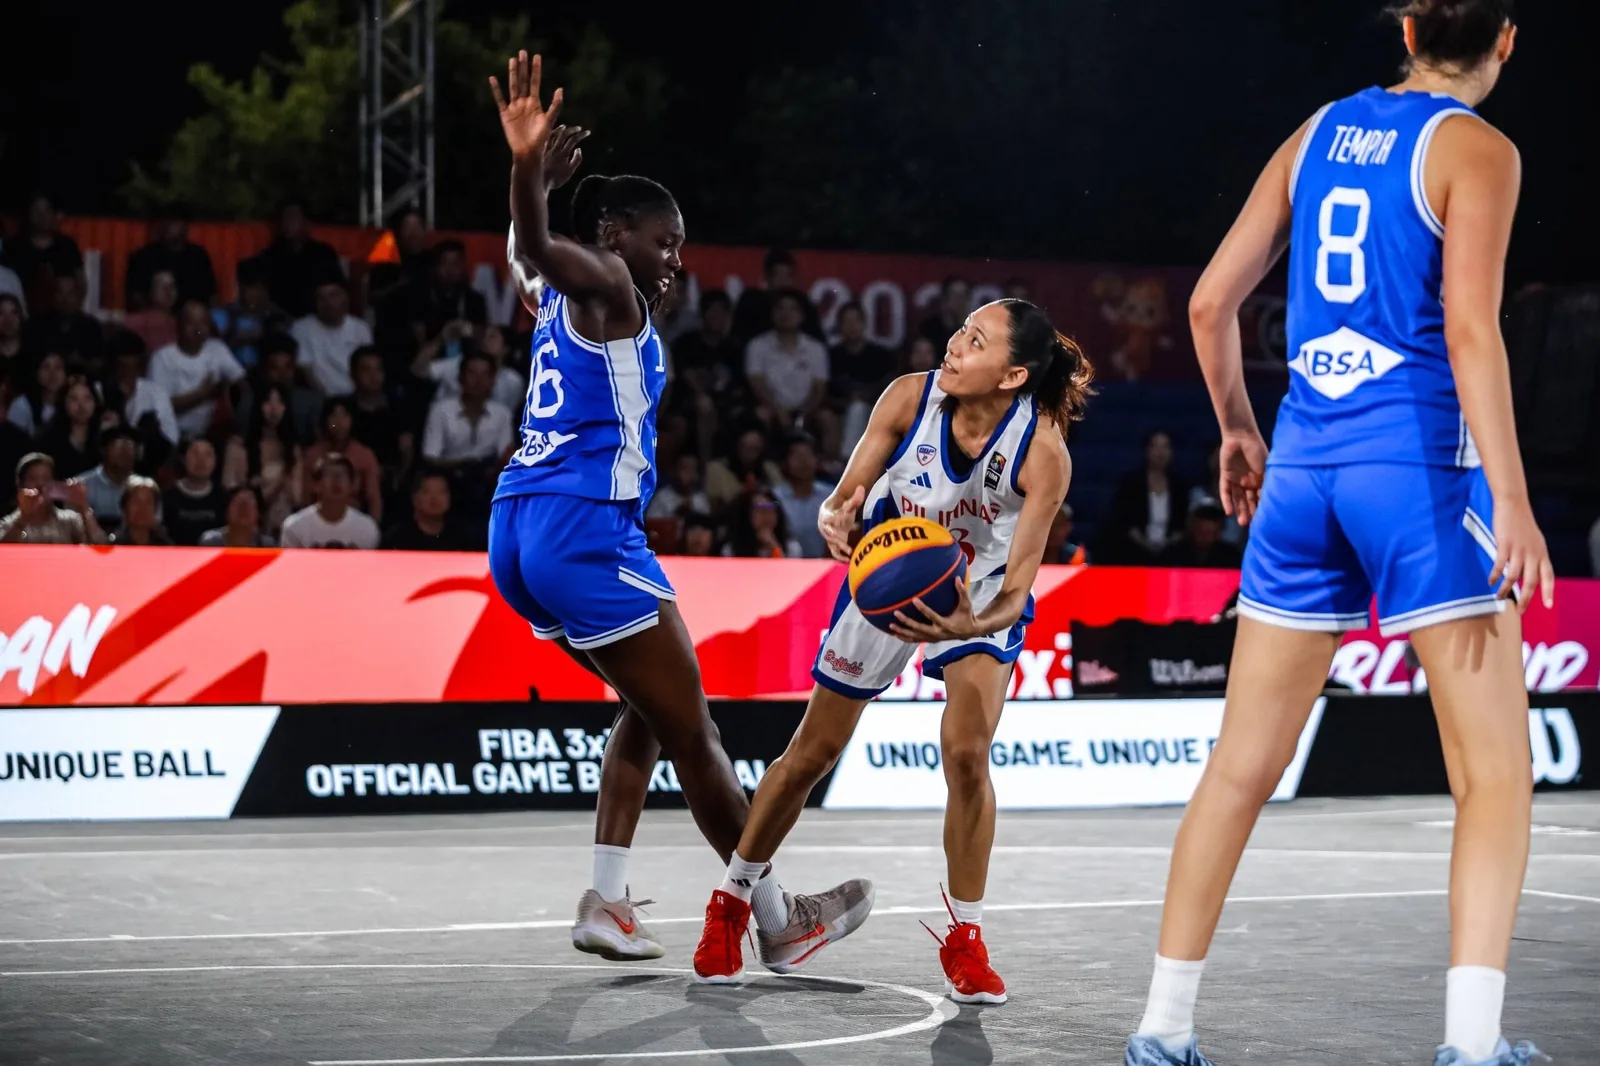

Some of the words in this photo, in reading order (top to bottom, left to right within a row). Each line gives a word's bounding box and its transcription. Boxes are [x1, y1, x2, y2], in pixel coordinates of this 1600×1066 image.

[1327, 124, 1398, 166] TEMPIA
[1315, 186, 1371, 304] 8
[854, 526, 929, 567] Wilson
[479, 729, 558, 760] FIBA
[564, 728, 614, 760] 3x
[866, 742, 940, 770] UNIQ
[990, 740, 1082, 768] GAME,
[1089, 738, 1201, 767] UNIQUE
[0, 751, 124, 783] UNIQUE
[132, 749, 226, 779] BALL
[307, 763, 469, 797] OFFICIAL
[473, 761, 573, 794] GAME
